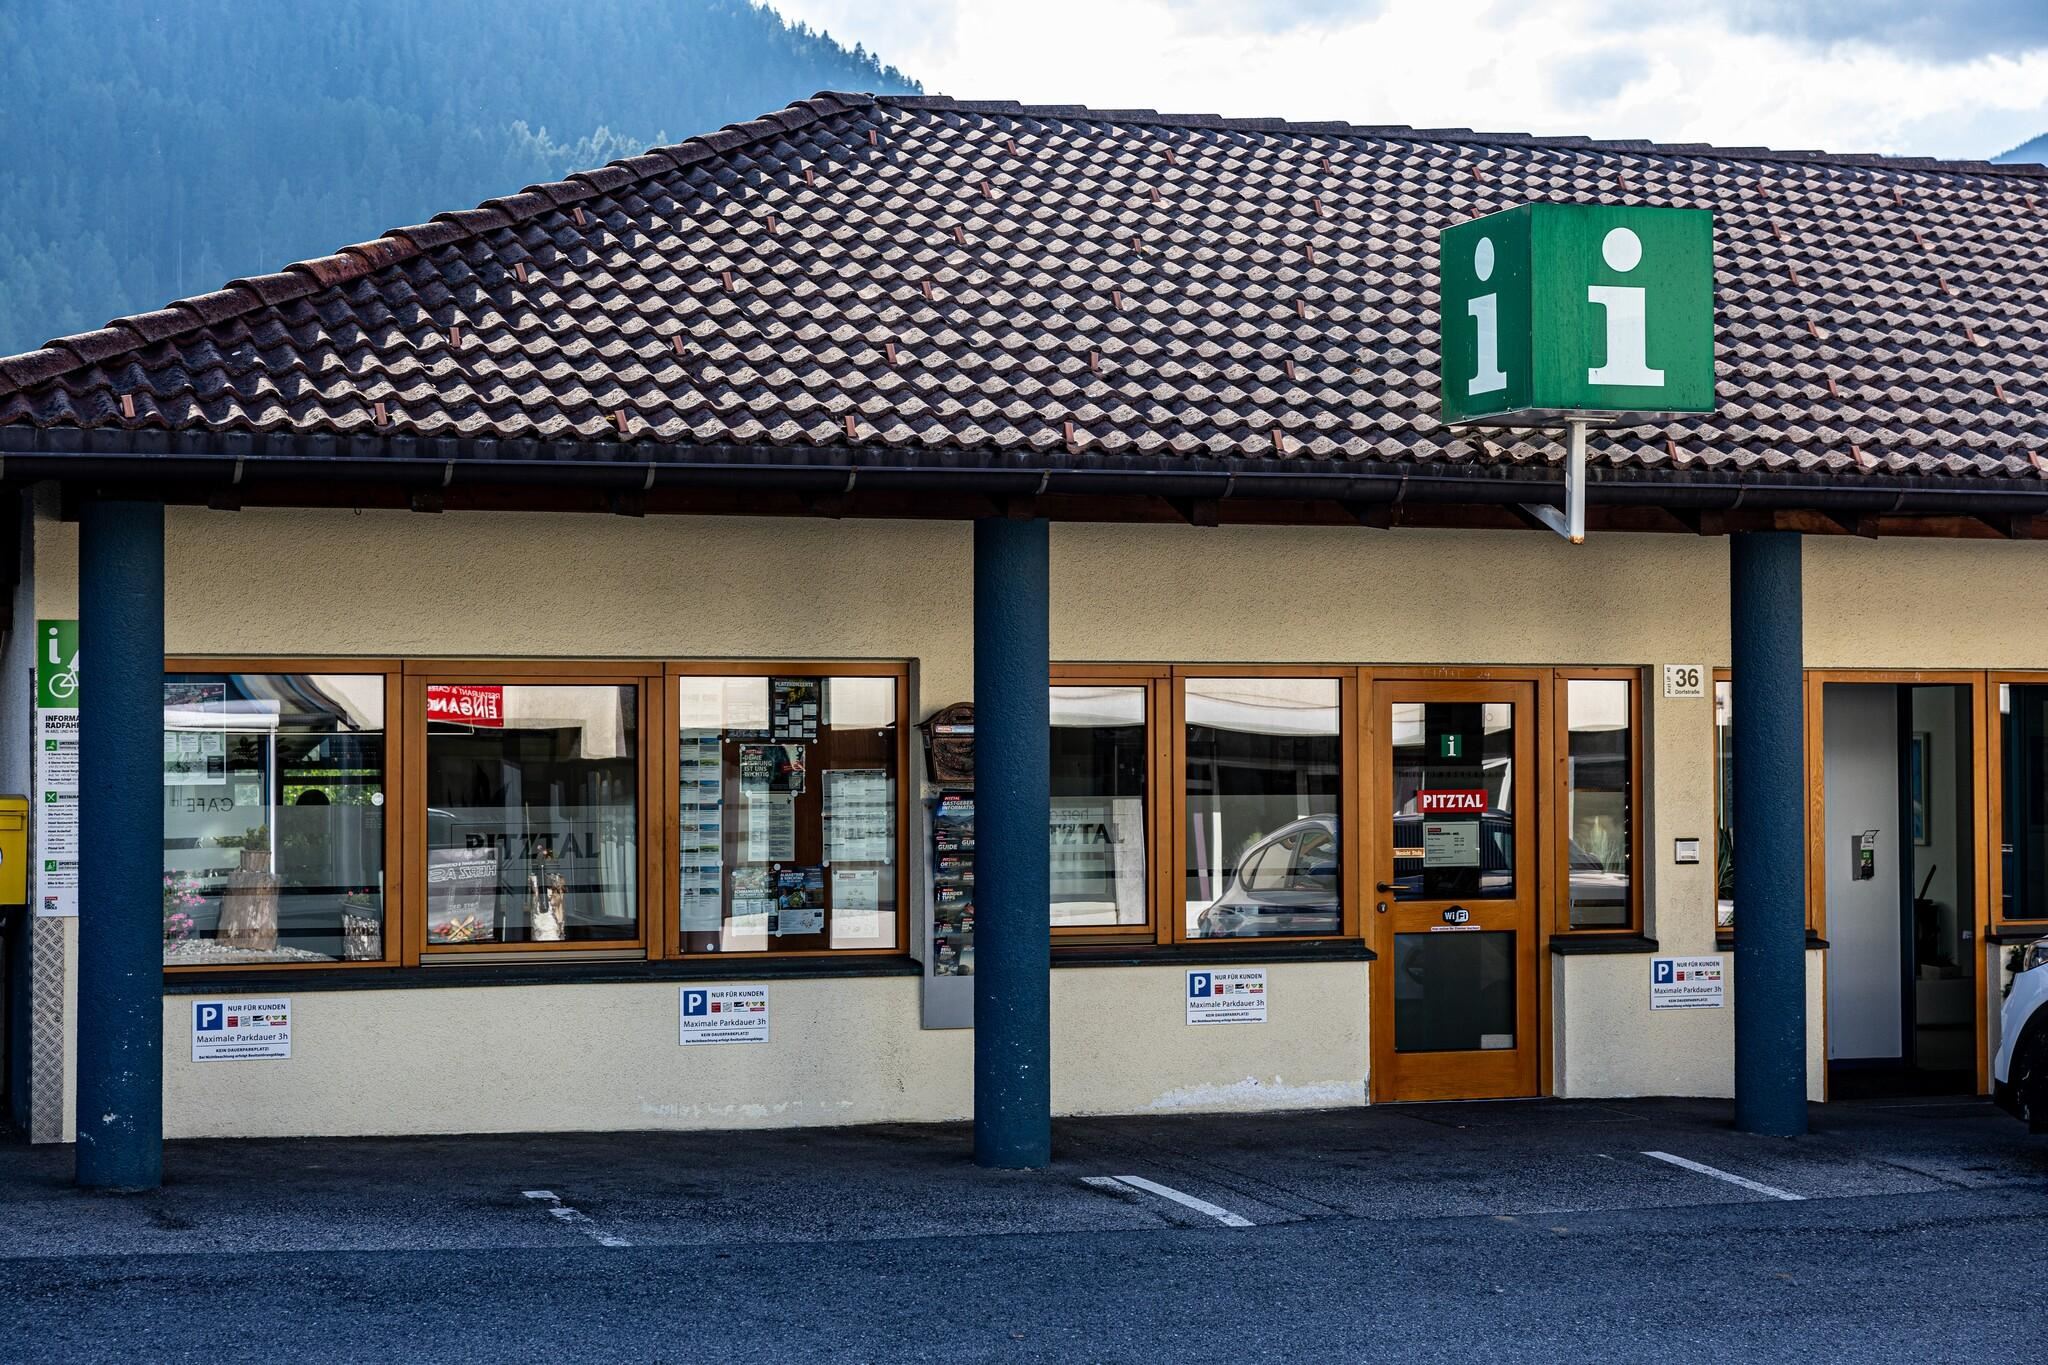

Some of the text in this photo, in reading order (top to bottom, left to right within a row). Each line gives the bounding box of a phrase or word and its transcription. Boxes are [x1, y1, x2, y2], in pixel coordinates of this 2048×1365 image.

[1676, 668, 1699, 688] 36
[1422, 794, 1484, 808] PITZTAL
[1658, 964, 1669, 981] P
[1194, 976, 1206, 994] P
[688, 994, 702, 1013] P
[202, 1007, 217, 1027] P
[683, 1020, 718, 1028] Maximale
[196, 1035, 235, 1044] Maximale
[236, 1034, 276, 1042] Parkdauer
